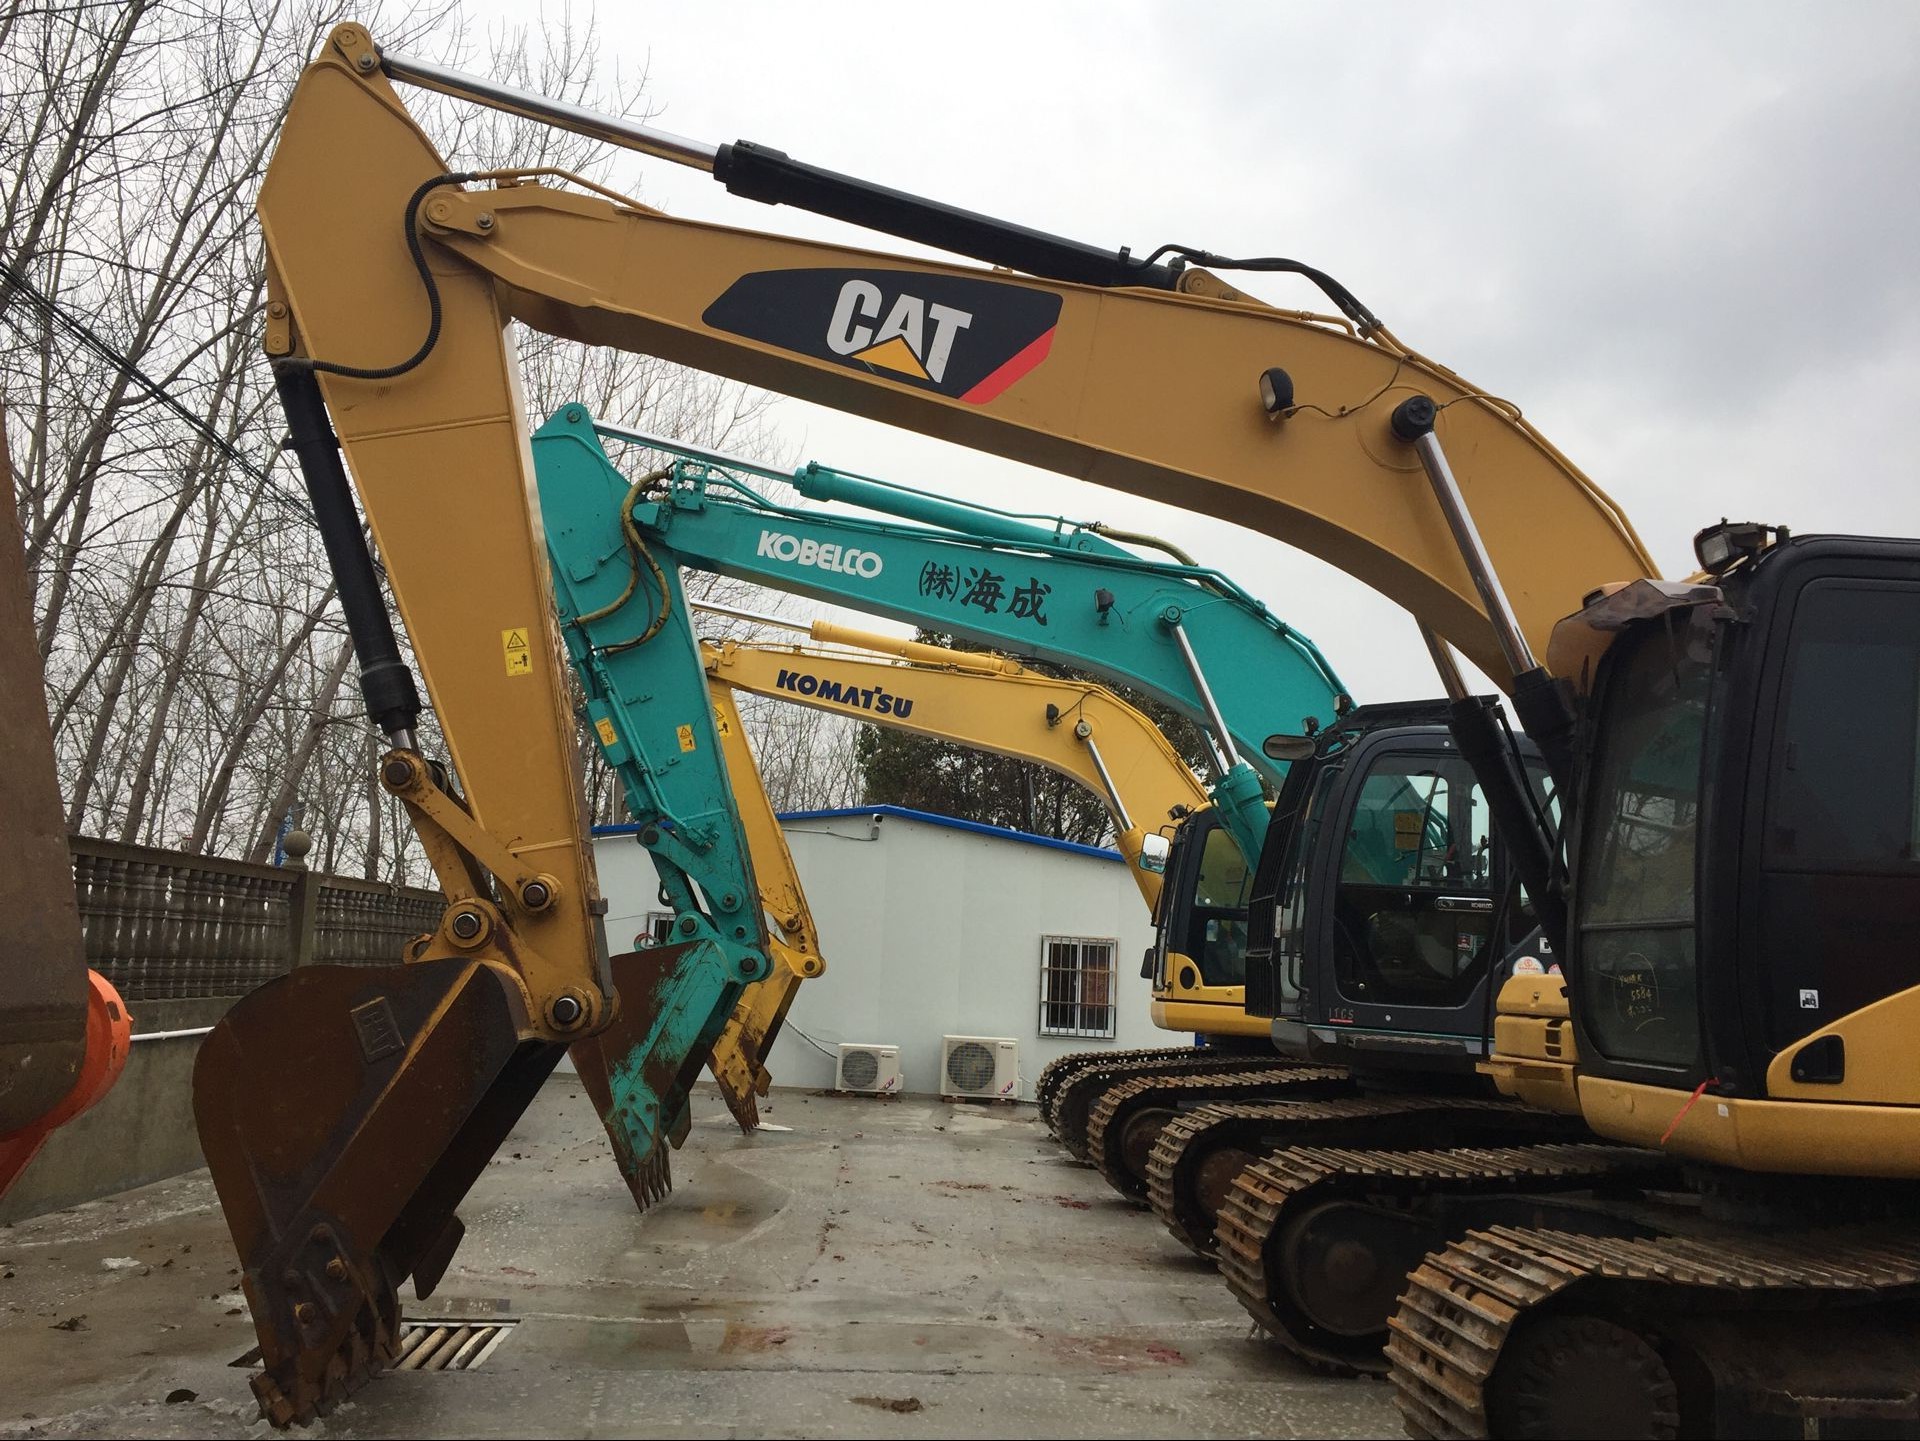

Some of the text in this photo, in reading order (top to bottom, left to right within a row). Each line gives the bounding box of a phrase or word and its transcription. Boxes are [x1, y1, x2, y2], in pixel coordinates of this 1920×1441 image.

[826, 279, 973, 383] CAT
[757, 530, 883, 579] KOBELCO
[776, 669, 913, 718] KOMATSU
